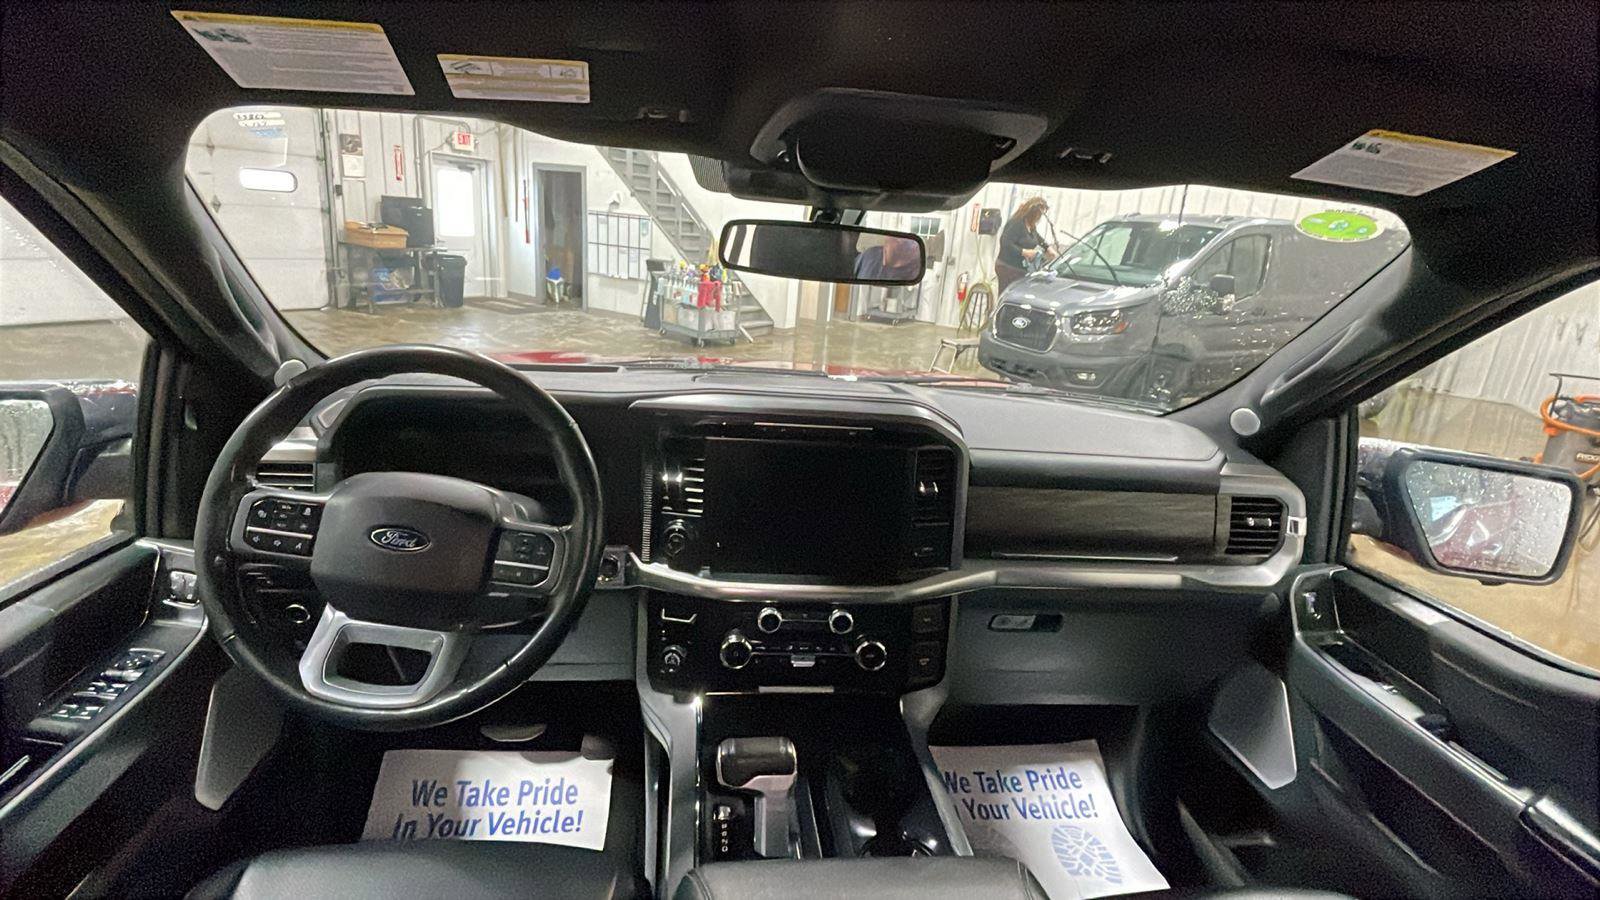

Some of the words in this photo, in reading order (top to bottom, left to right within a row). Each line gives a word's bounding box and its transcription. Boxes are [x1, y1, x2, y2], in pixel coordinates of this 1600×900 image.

[381, 530, 417, 548] Ford
[412, 780, 448, 807] We
[457, 779, 510, 807] Take
[517, 777, 578, 806] Pride
[944, 770, 971, 794] We
[973, 769, 1023, 793] Take
[1025, 766, 1083, 792] Pride
[962, 798, 1010, 820] Your
[1011, 793, 1098, 820] Vehicle!
[392, 813, 418, 840] In
[428, 812, 482, 838] Your
[489, 809, 583, 836] Vehicle!
